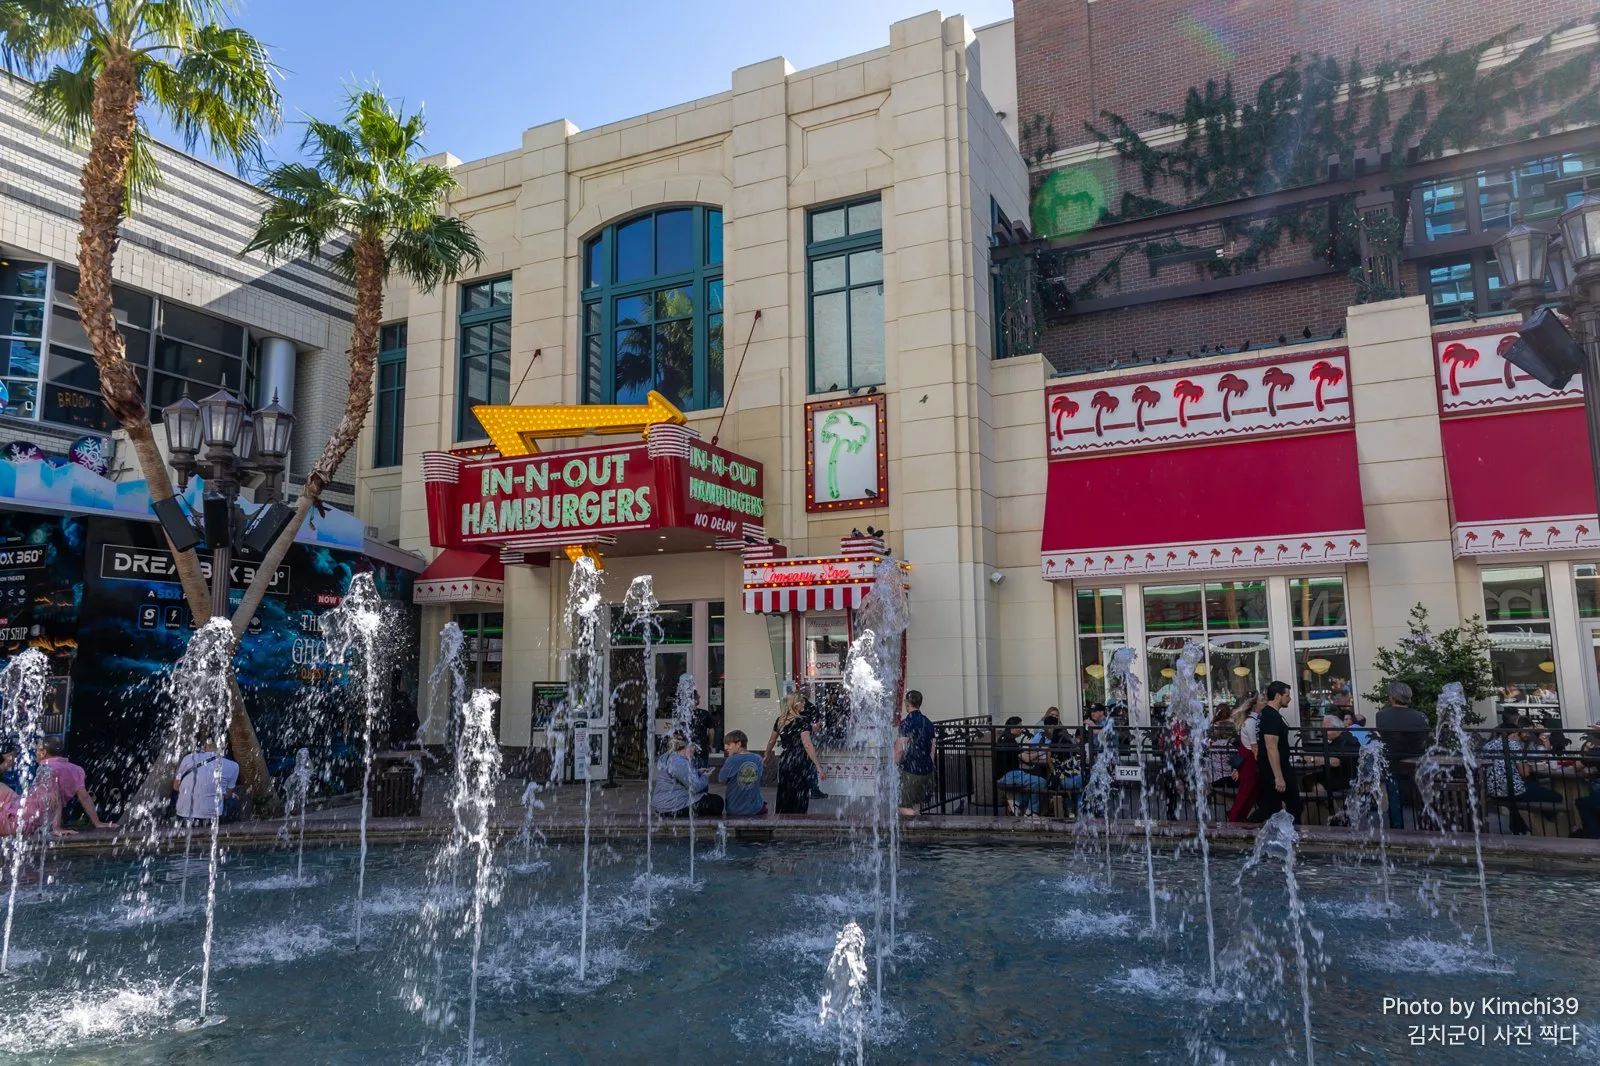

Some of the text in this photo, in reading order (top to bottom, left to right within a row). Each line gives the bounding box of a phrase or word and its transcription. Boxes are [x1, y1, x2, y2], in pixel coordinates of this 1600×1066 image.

[481, 453, 630, 497] IN-N-OUT
[689, 446, 758, 487] IN-N-OUT
[689, 476, 764, 518] HAMBURGERS
[461, 486, 651, 535] HAMBURGERS
[694, 513, 737, 534] NO DELAY
[763, 562, 851, 586] Company Store
[318, 595, 338, 604] NOW
[10, 627, 28, 640] SHIP
[815, 661, 837, 669] OPEN
